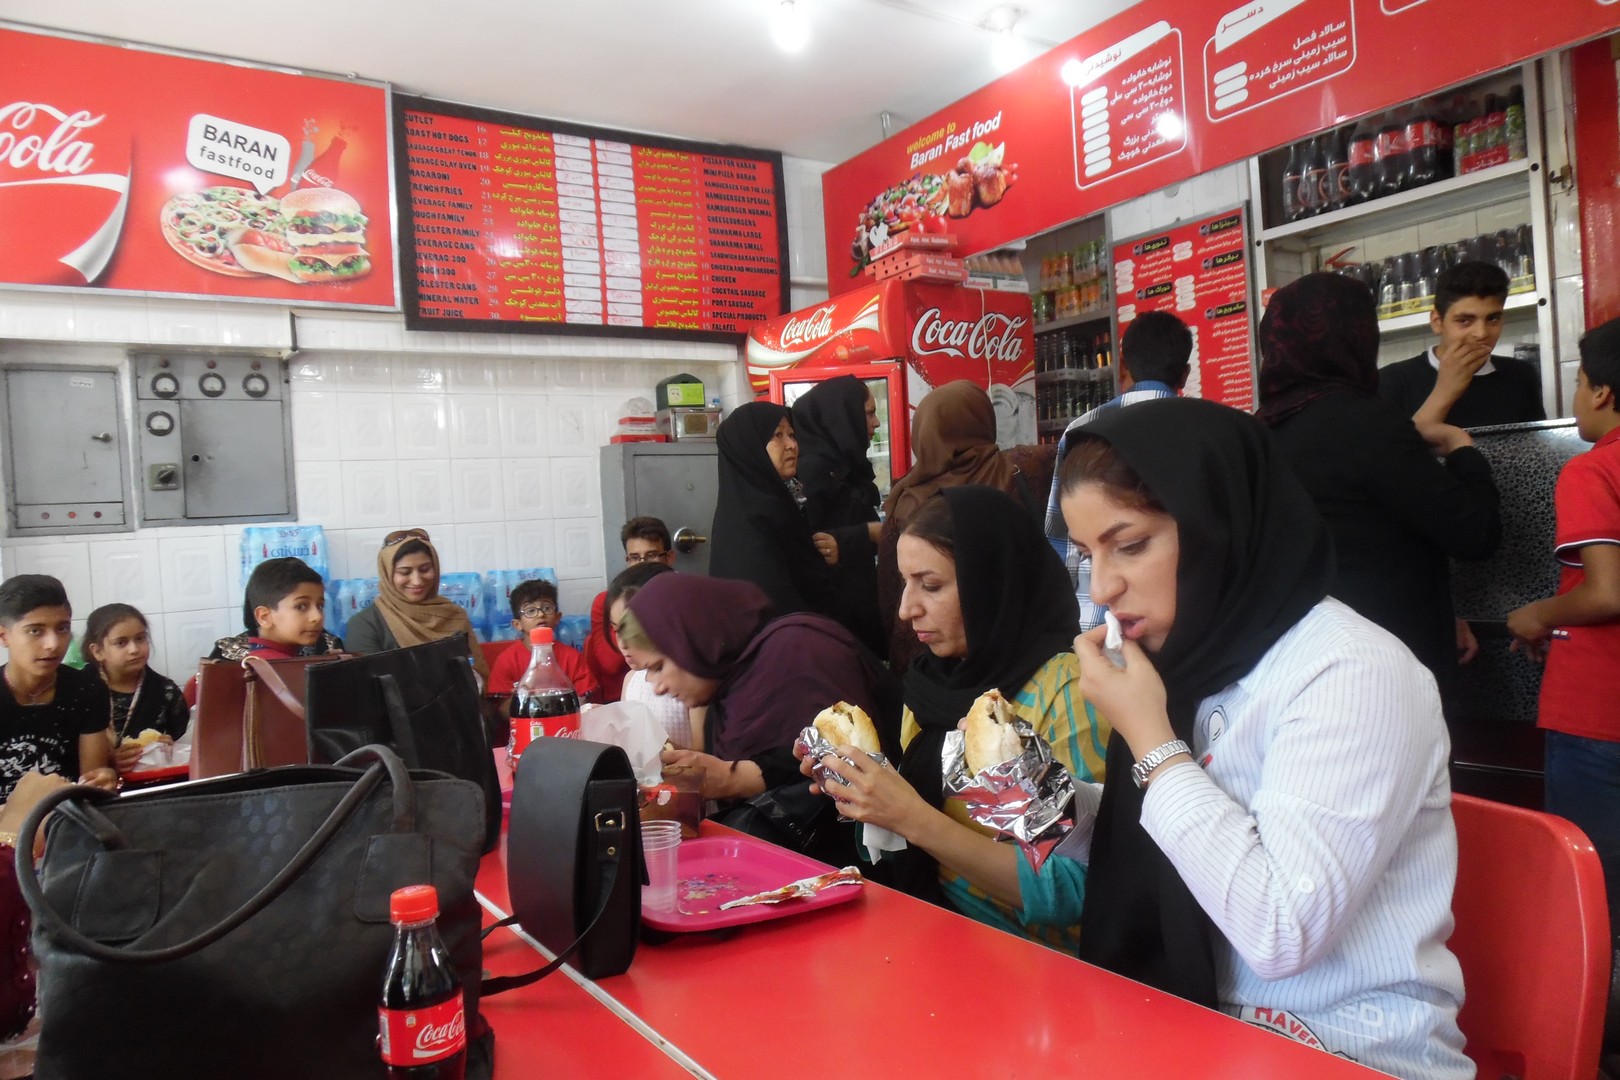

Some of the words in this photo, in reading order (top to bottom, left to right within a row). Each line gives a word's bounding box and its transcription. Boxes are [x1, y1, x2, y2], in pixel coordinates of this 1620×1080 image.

[1221, 6, 1264, 34] دسر
[1319, 21, 1346, 37] سالاد
[1292, 30, 1317, 50] فصل
[1321, 35, 1347, 51] سیب
[1087, 48, 1122, 76] نوشیدن
[1293, 46, 1321, 65] زمینی
[1323, 50, 1348, 66] سالاد
[1147, 56, 1172, 76] نوشابه
[1273, 58, 1293, 72] سرخ
[1296, 61, 1321, 76] سیب
[1122, 68, 1147, 85] خانواده
[1249, 66, 1271, 80] کرده
[1269, 70, 1296, 89] زمینی
[1133, 89, 1159, 105] خانواده
[1159, 84, 1173, 96] دوغ
[432, 131, 446, 140] HOT
[907, 127, 945, 154] welcome
[946, 121, 957, 134] to
[910, 143, 943, 170] Baran
[945, 126, 971, 153] Fast
[972, 110, 1002, 140] food
[203, 124, 278, 162] BARAN
[408, 143, 436, 152] AUSAGE
[200, 145, 275, 180] fastfood
[409, 156, 439, 166] AUSAGE
[440, 159, 457, 168] CLAY
[459, 161, 477, 170] OVEN
[440, 186, 463, 195] FRIES
[411, 196, 446, 207] EVERAGE
[448, 201, 473, 210] FAMILY
[437, 212, 465, 222] FAMILY
[414, 224, 451, 234] ELESTER
[452, 228, 480, 237] FAMILY
[415, 238, 453, 248] EVERAGE
[454, 241, 475, 250] CANS
[416, 252, 449, 262] EVERAG
[711, 275, 736, 283] CHICKEN
[456, 283, 477, 291] CANS
[712, 287, 739, 295] COCKTAIL
[740, 290, 766, 298] SAUSAGE
[453, 296, 479, 304] WATER
[728, 301, 754, 309] SAUSAGE
[442, 309, 463, 317] JUICE
[712, 312, 736, 320] SPECIAL
[780, 304, 837, 349] Coca-Cola
[912, 308, 1027, 361] Coca-Cola
